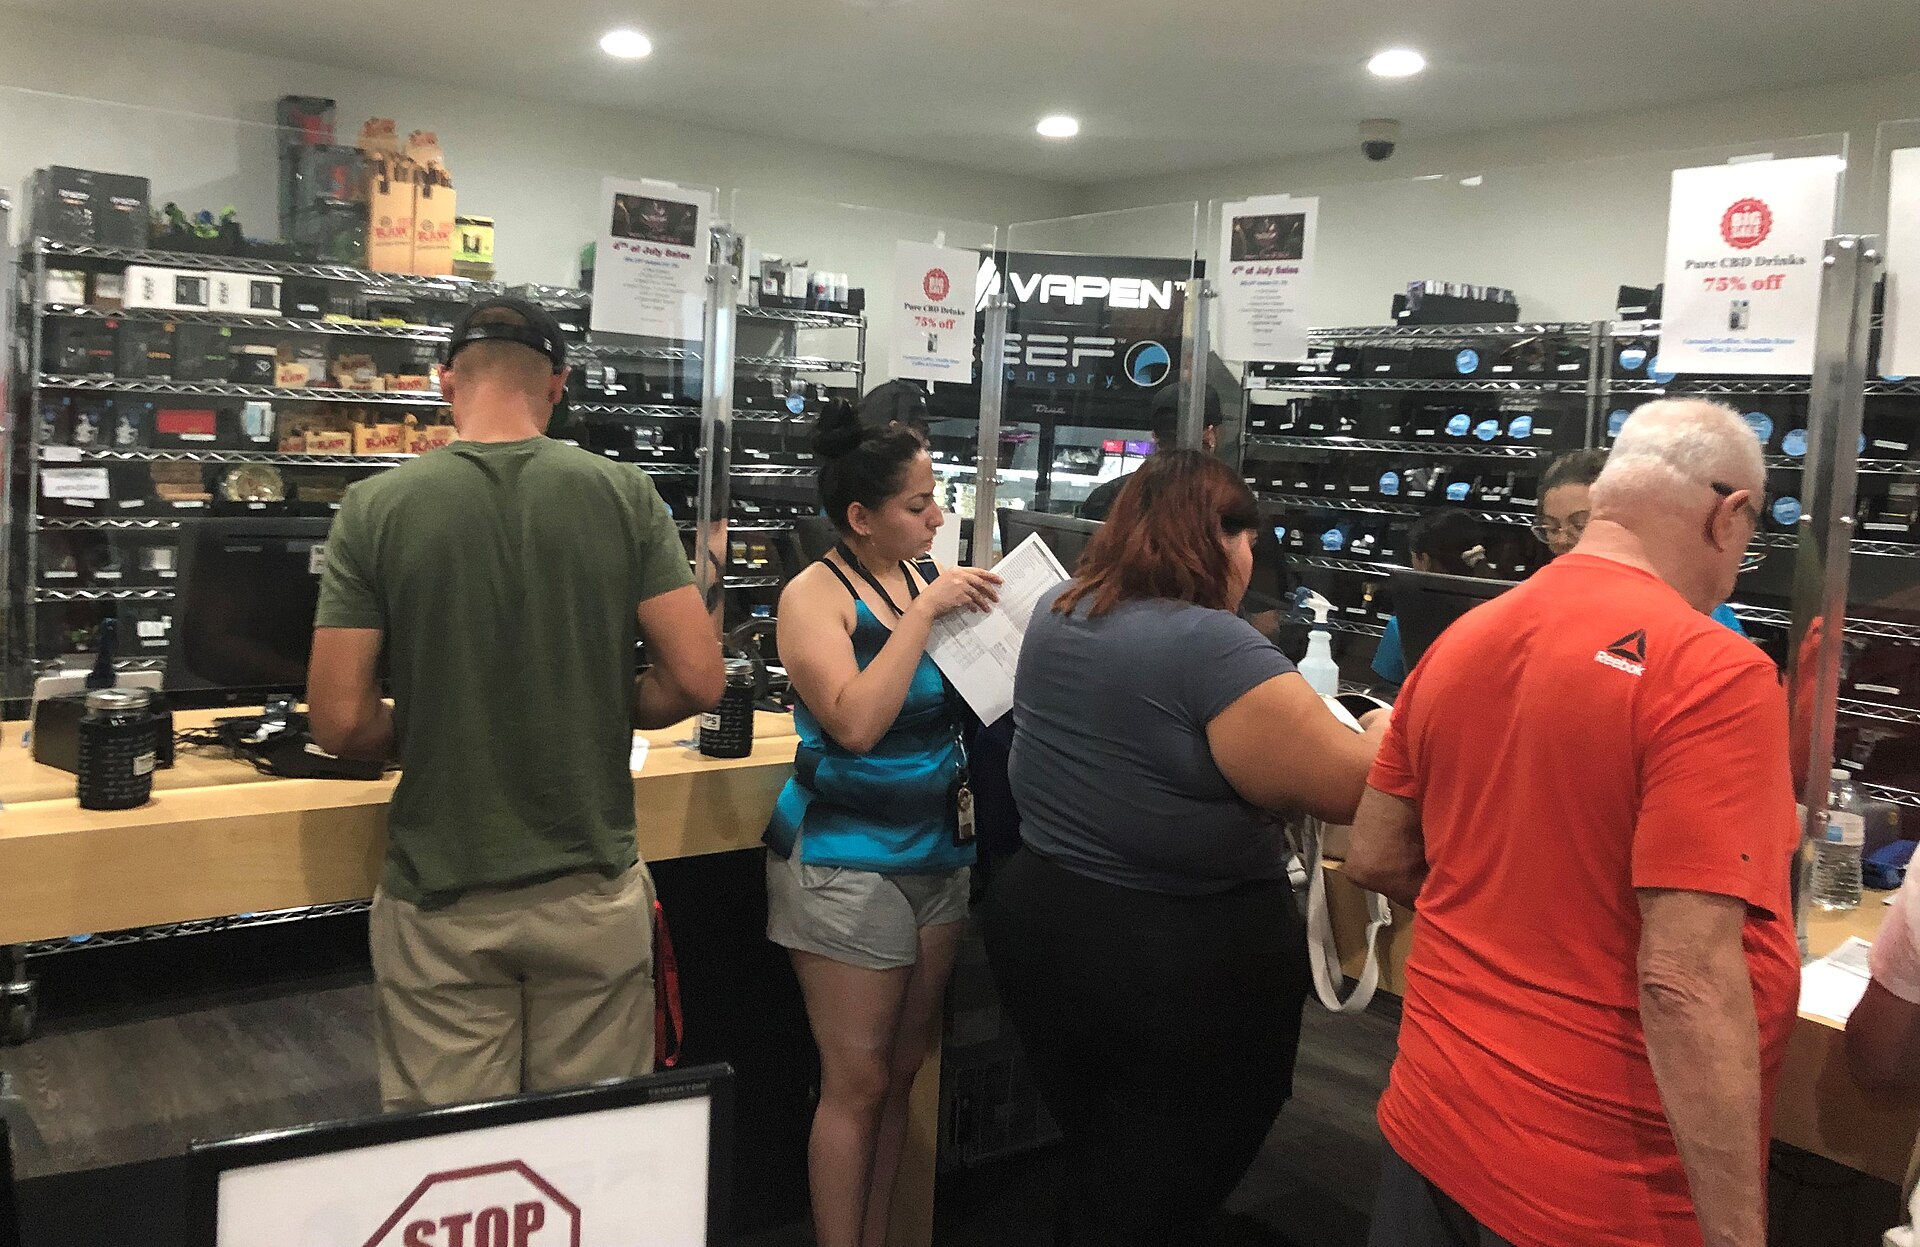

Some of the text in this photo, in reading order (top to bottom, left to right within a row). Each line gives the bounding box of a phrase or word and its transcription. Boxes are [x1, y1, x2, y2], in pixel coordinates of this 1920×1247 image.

[630, 245, 641, 253] of
[642, 247, 662, 258] July
[665, 249, 691, 260] Sales
[1684, 253, 1807, 270] Pure CBD Drinks
[1245, 266, 1254, 275] of
[1256, 266, 1274, 277] July
[1275, 266, 1299, 275] Sales
[1703, 274, 1786, 292] 75% off
[1009, 272, 1172, 310] VAPEN
[903, 302, 966, 316] Pure CBD Drinks
[914, 315, 957, 330] 75% off
[366, 435, 398, 449] RAW
[1593, 650, 1646, 677] Reebok
